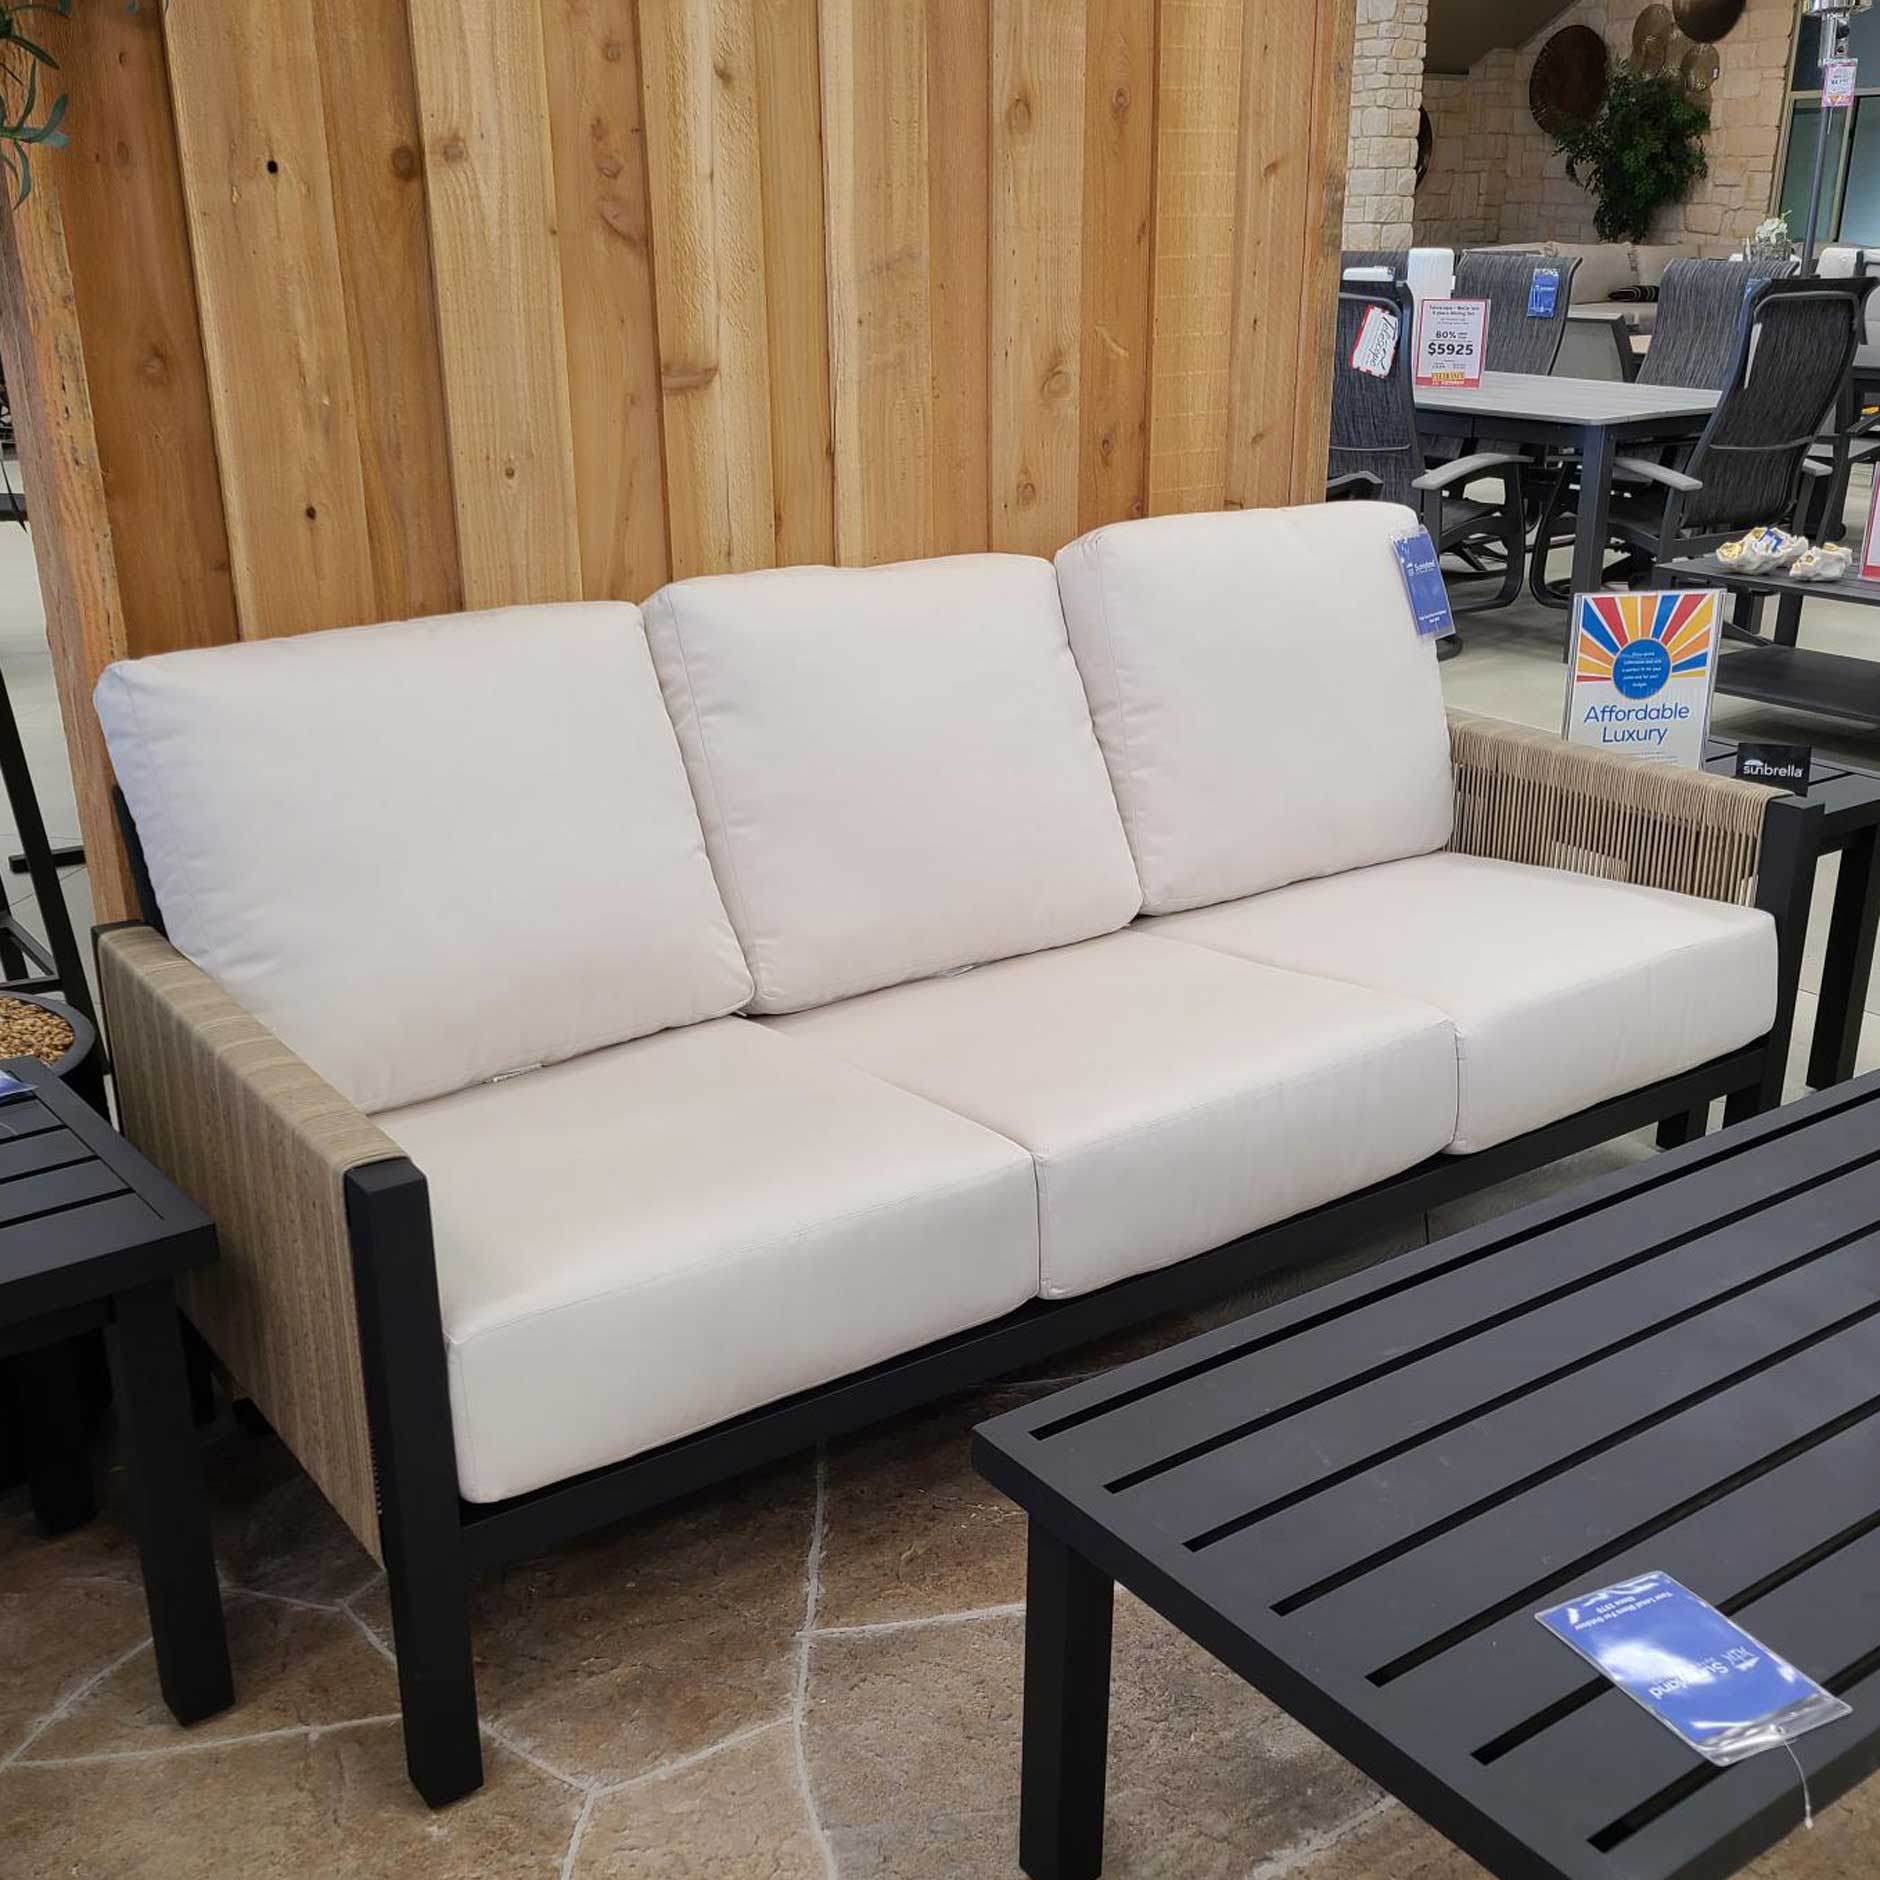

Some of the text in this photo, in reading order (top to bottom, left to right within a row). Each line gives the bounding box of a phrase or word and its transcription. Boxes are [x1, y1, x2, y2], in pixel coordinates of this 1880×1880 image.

[1436, 331, 1457, 339] 60%
[1428, 342, 1473, 356] $5925
[1584, 702, 1690, 723] Affordable
[1603, 726, 1668, 746] Luxury
[1743, 761, 1804, 778] sunbrella
[1648, 1661, 1729, 1700] Suland
